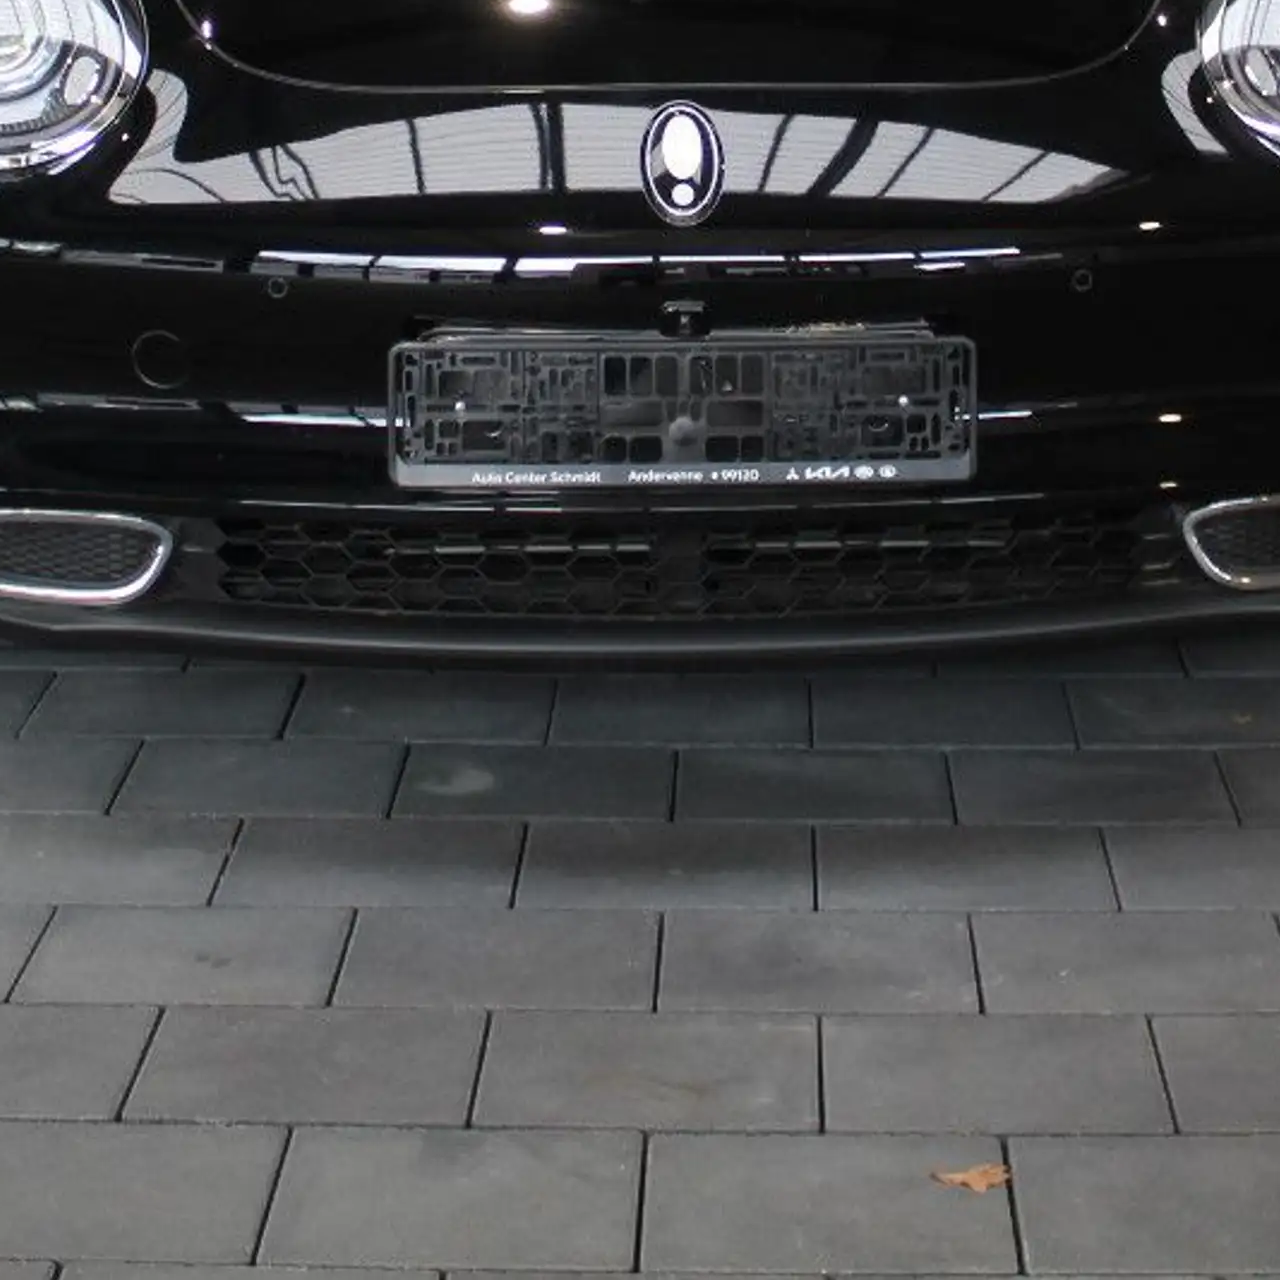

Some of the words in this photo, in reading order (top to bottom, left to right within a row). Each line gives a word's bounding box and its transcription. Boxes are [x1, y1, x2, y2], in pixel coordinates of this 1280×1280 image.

[472, 471, 502, 484] Auto
[506, 471, 547, 484] Center
[550, 470, 601, 484] Schmidt
[804, 465, 851, 480] KIA
